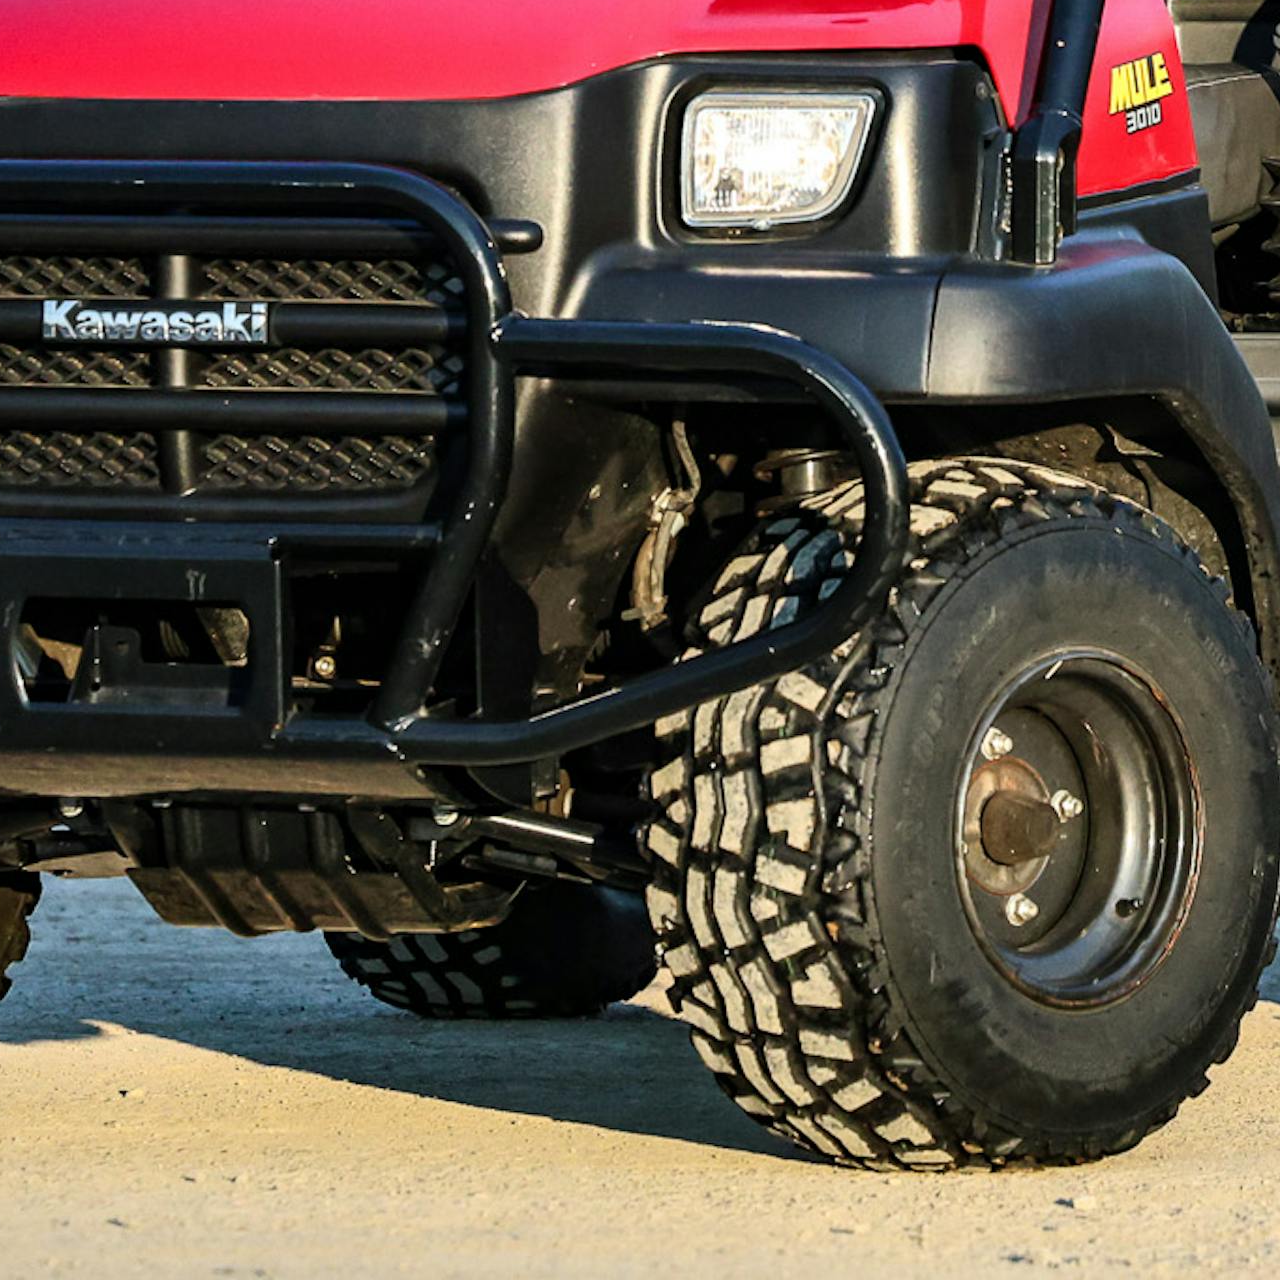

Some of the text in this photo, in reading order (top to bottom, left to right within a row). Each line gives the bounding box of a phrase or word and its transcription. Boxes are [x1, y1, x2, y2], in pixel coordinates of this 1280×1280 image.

[1108, 51, 1173, 115] MULE
[1125, 102, 1162, 134] 3010
[42, 299, 268, 343] Kawasaki
